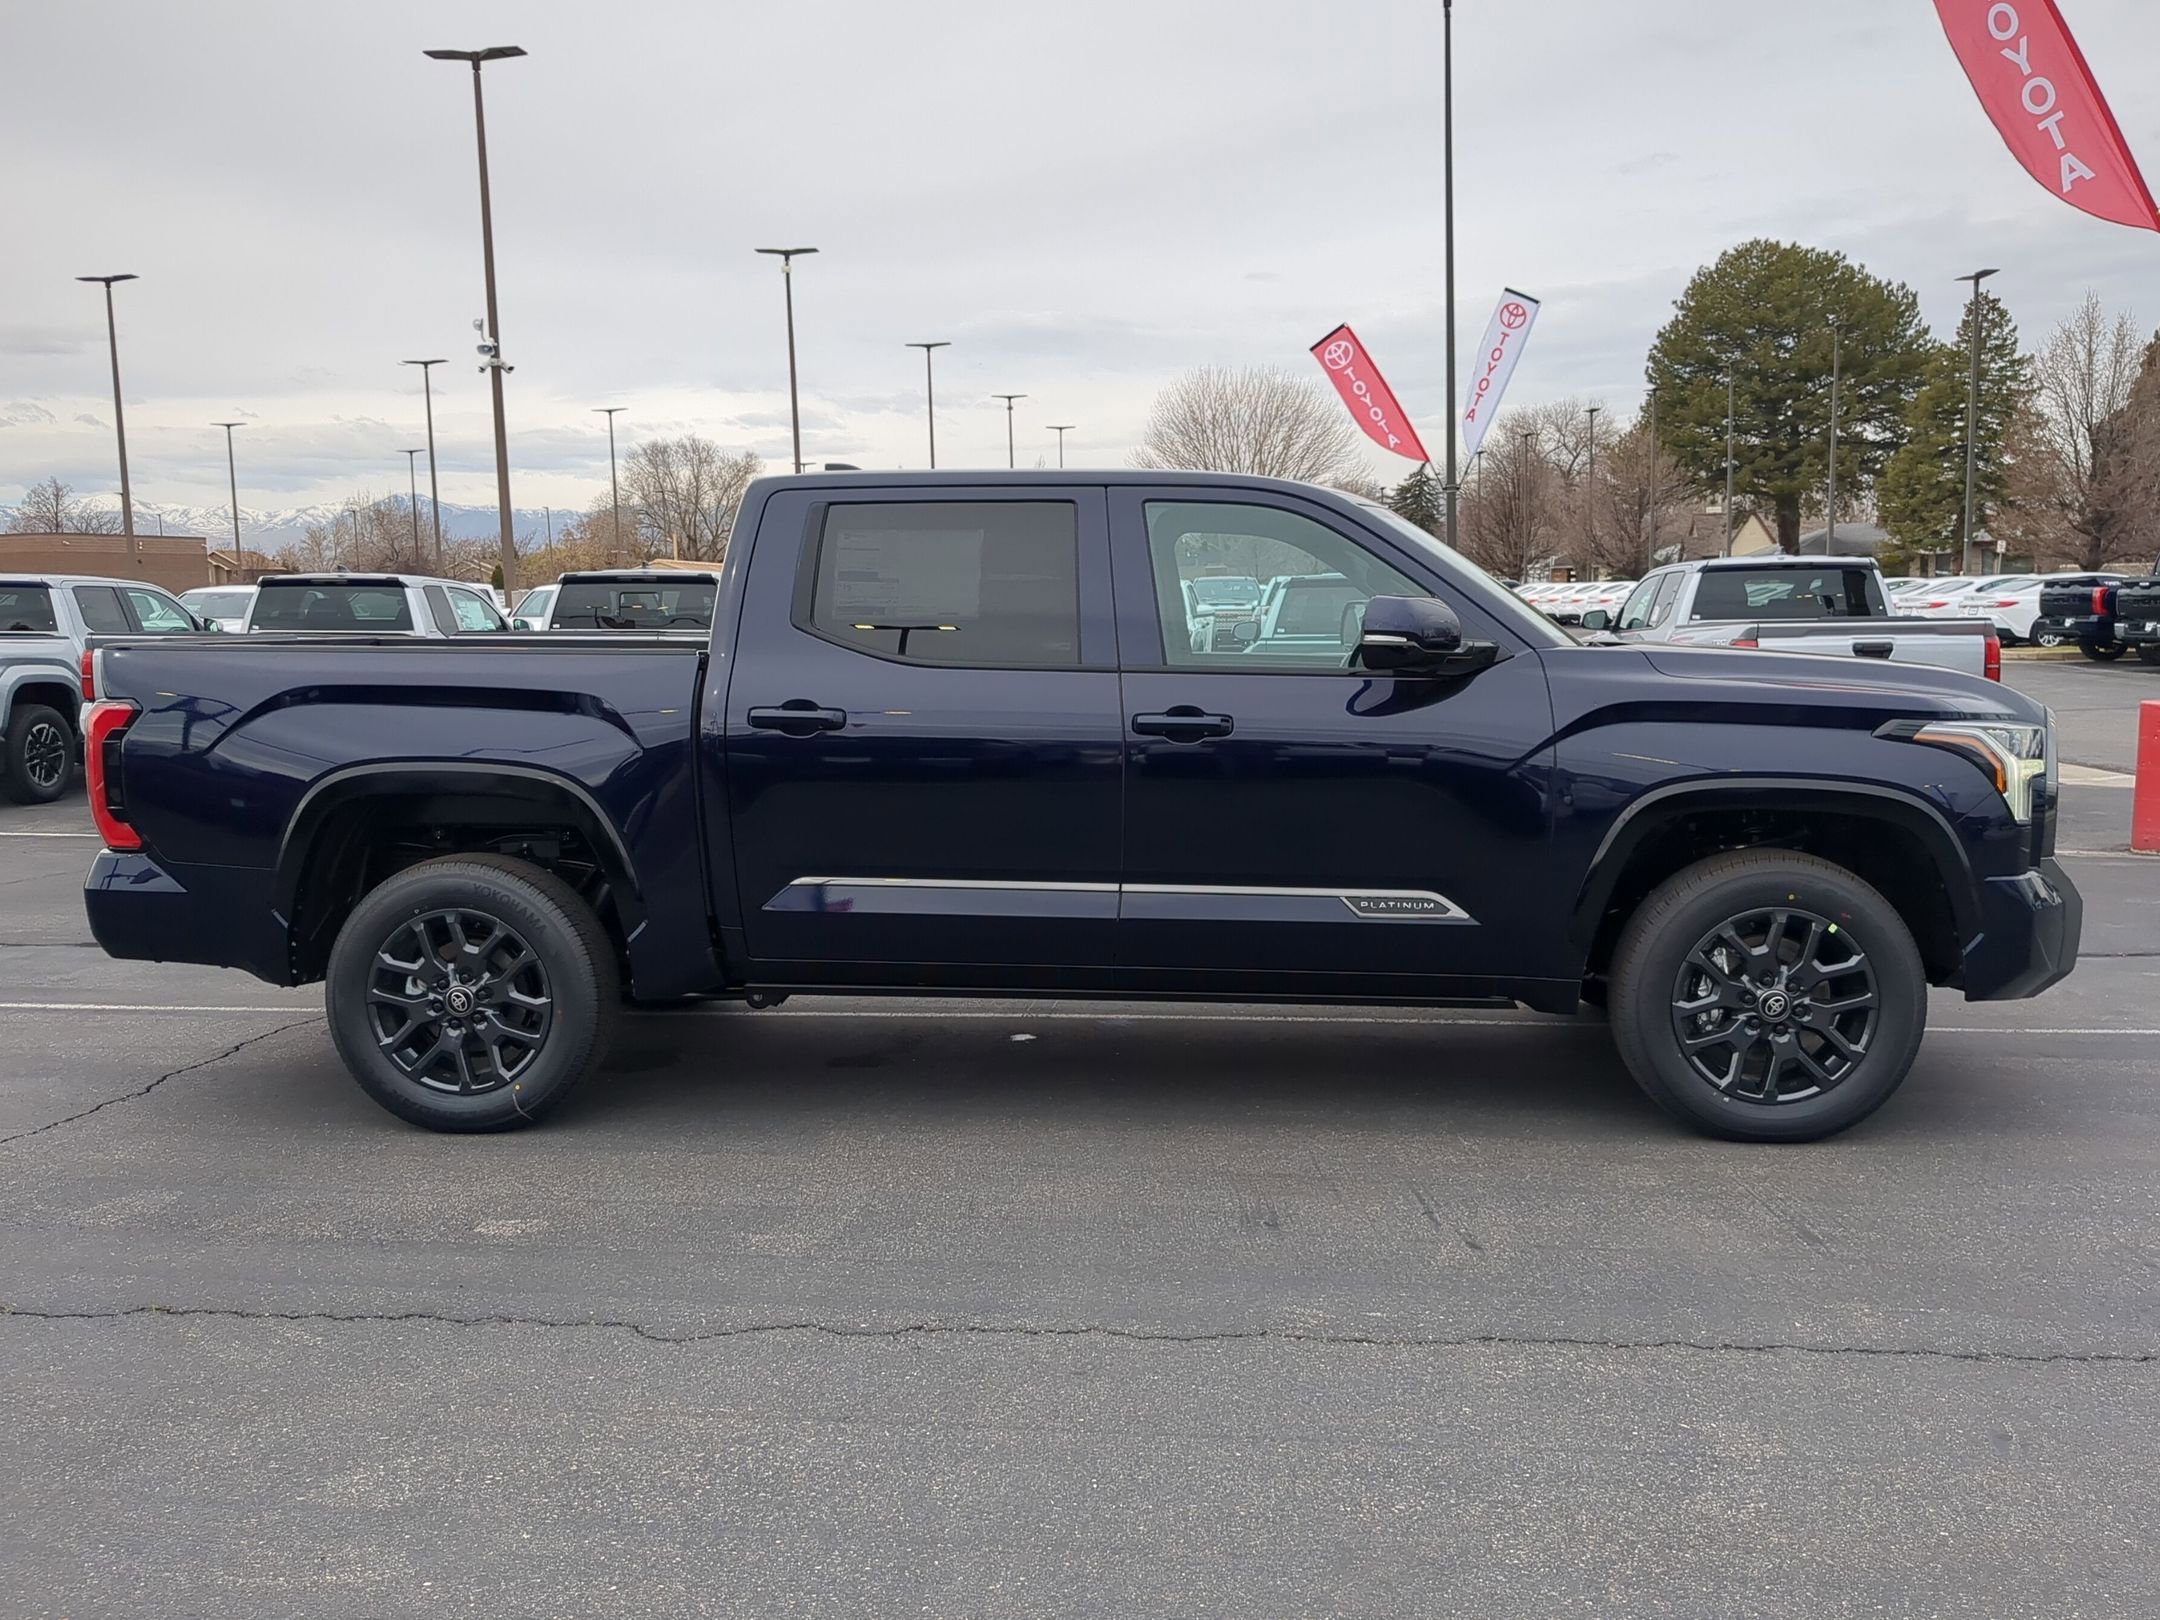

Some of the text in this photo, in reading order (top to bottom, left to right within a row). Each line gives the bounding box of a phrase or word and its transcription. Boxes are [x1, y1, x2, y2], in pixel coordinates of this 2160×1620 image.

[1986, 0, 2096, 193] OYOTA
[1344, 366, 1401, 449] TOYOTA
[1465, 332, 1510, 423] TOYOTA
[473, 883, 546, 932] YOKOHAMA
[1360, 901, 1435, 909] PLATINUM
